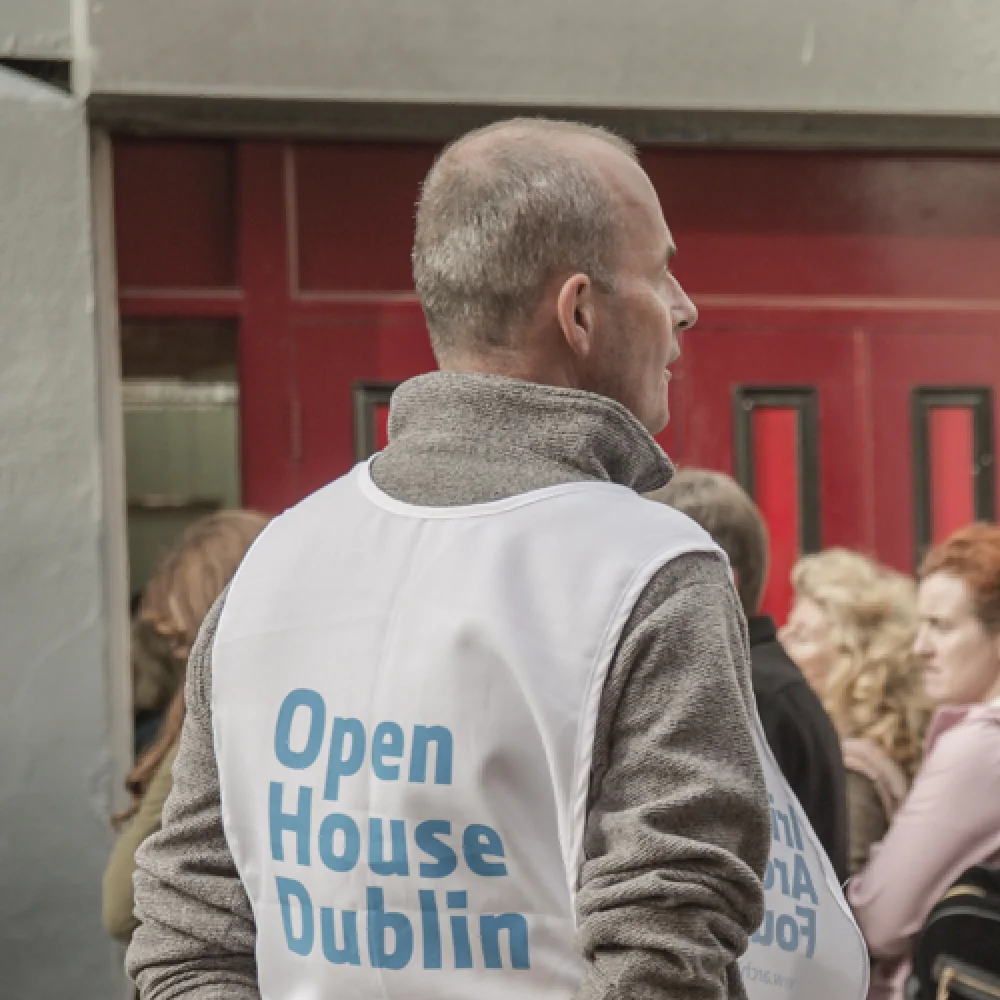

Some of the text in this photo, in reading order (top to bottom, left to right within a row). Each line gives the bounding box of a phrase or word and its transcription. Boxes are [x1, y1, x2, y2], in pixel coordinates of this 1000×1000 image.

[273, 687, 454, 801] Open
[268, 780, 508, 879] House
[274, 875, 531, 970] Dublin
